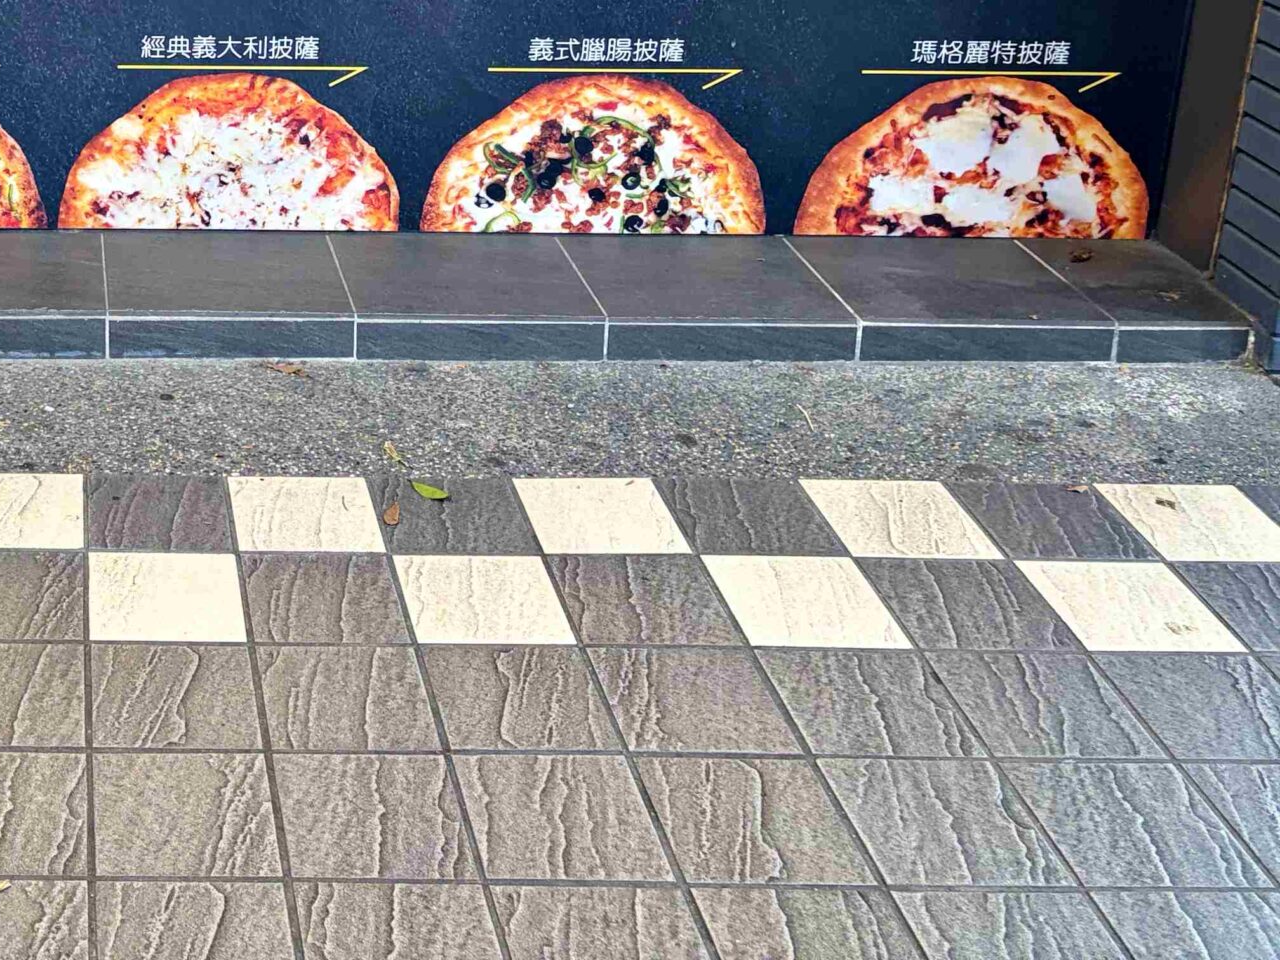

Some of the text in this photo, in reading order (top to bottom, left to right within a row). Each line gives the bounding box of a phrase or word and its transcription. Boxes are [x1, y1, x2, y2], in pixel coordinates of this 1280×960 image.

[141, 35, 320, 61] 經典義大利披薩
[528, 37, 686, 63] 義式臘腸披薩
[911, 40, 1070, 66] 瑪格麗特披薩
